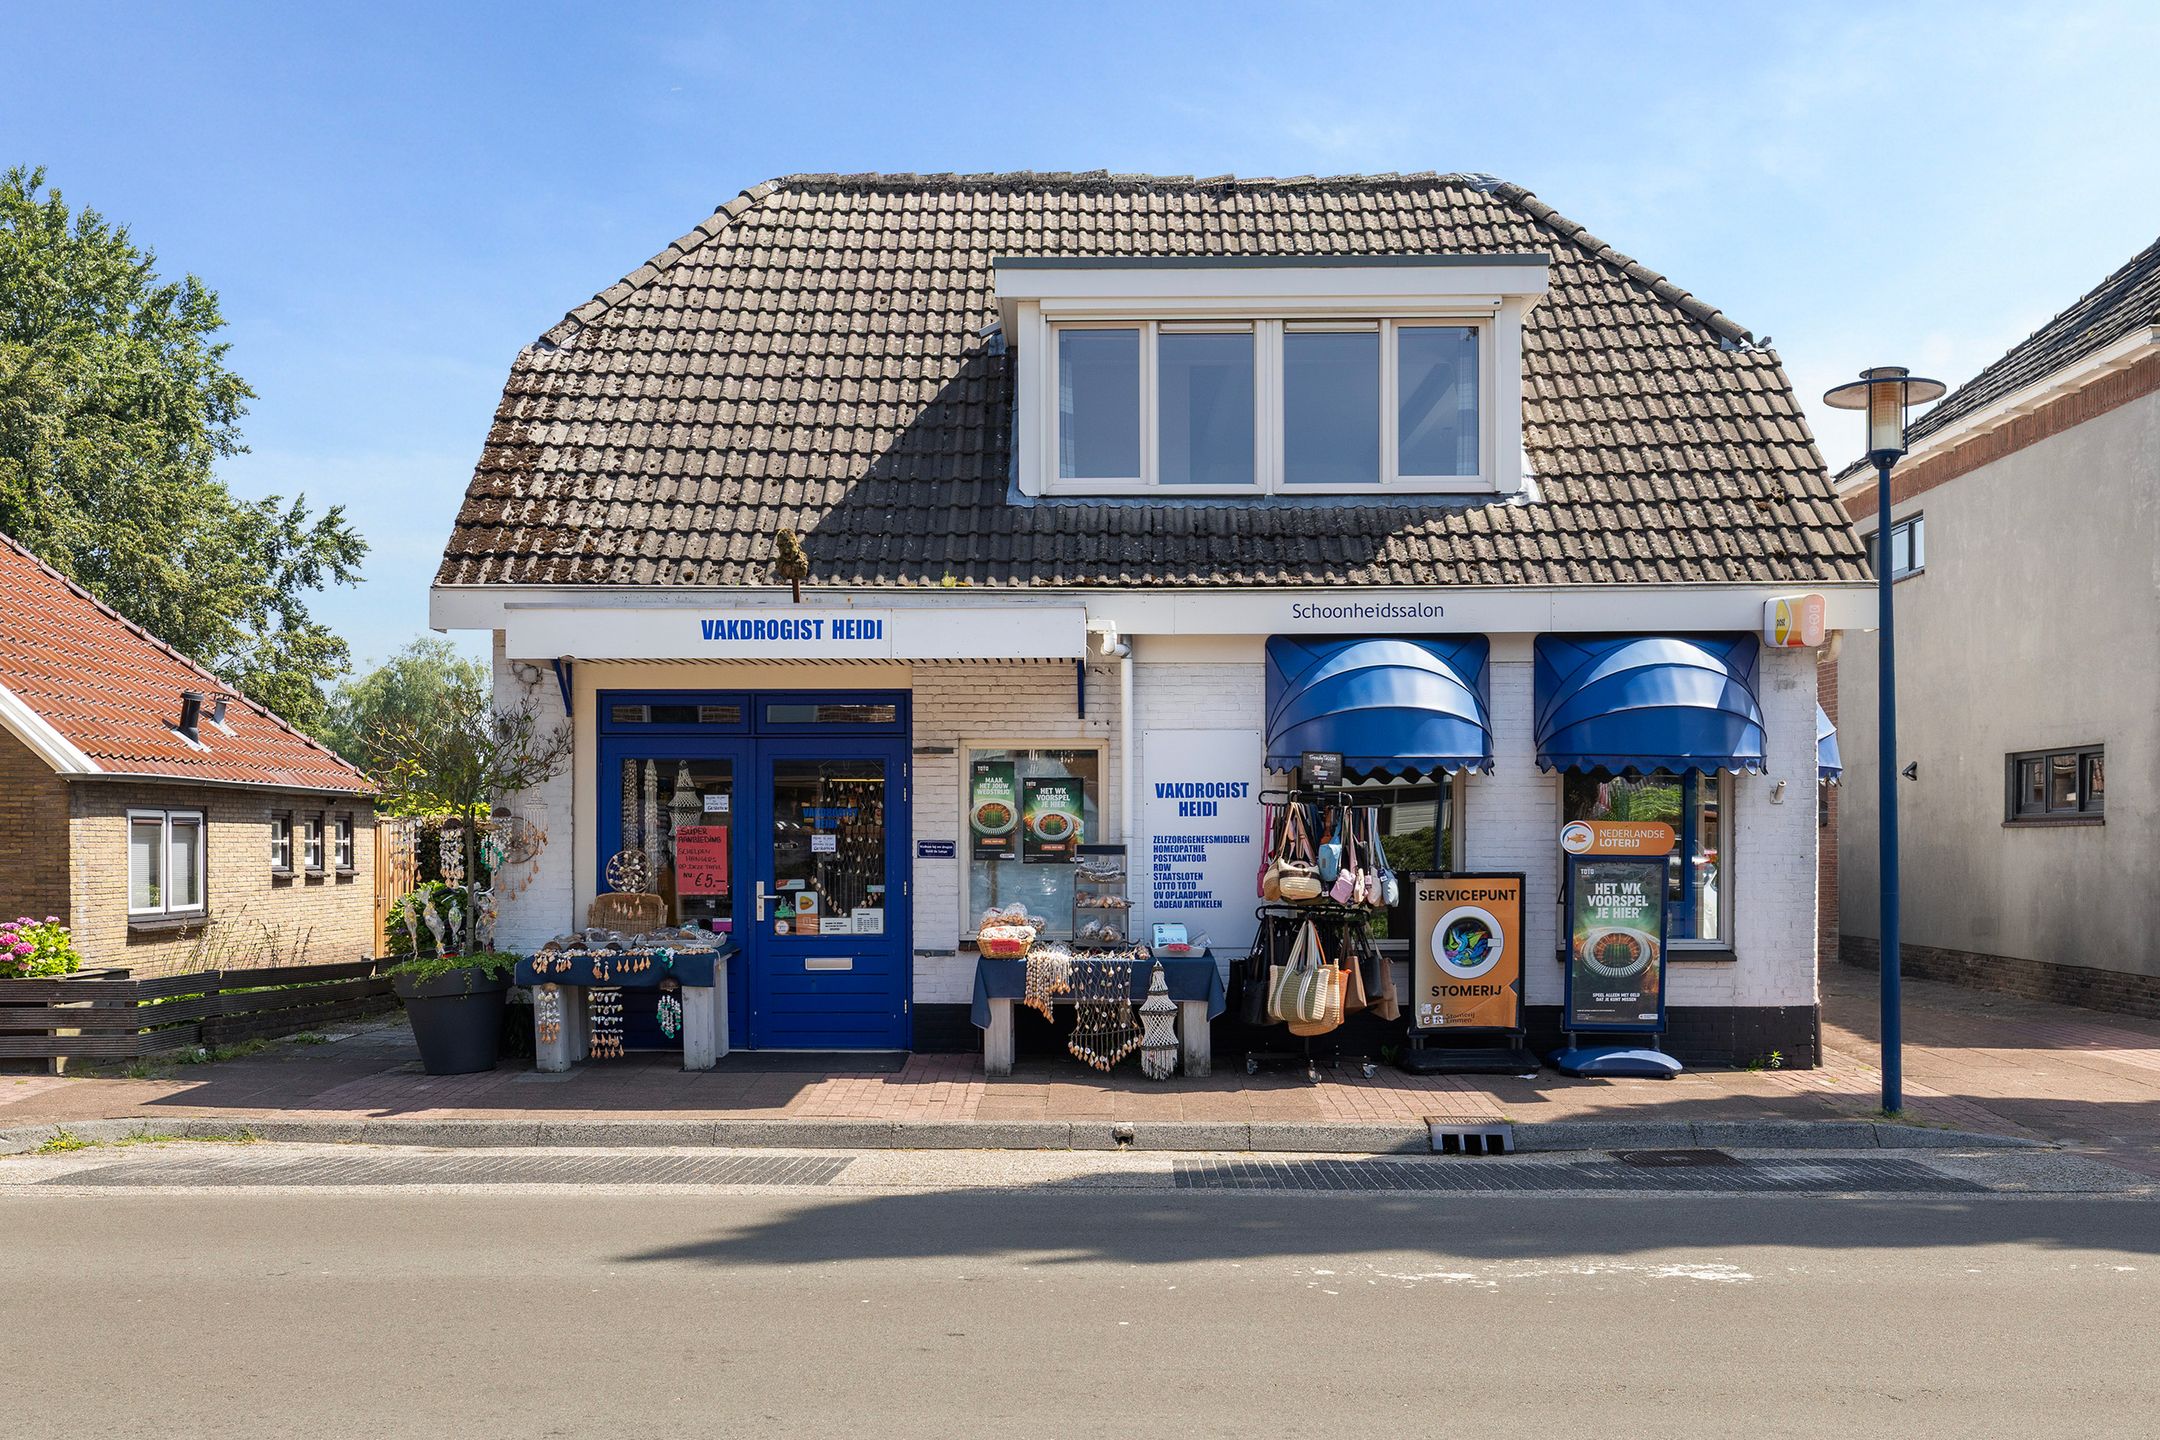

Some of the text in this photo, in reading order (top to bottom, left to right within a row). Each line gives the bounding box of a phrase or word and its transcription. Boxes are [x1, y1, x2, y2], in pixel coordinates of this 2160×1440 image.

[1292, 603, 1444, 618] Schoonheidssalon
[701, 619, 882, 640] VAKDROGIST HEIDI
[1155, 782, 1249, 799] VAKDROGIST
[1179, 801, 1217, 817] HEIDI
[680, 827, 708, 835] SUPER
[1599, 829, 1665, 839] NEDERLANDSE
[1153, 835, 1250, 844] ZELFZORGGENEESMIDDELEN
[1599, 838, 1640, 848] LOTERIJ
[1153, 845, 1205, 853] HOMEOPATHIE
[1153, 854, 1207, 862] POSTKANTOOR
[1153, 863, 1171, 872] RDW
[1153, 872, 1203, 881] STAATSLOTEN
[1153, 881, 1197, 890] LOTTO TOTO
[1595, 883, 1642, 895] HET WK
[1153, 891, 1213, 900] OV OPLAADPUNT
[1419, 889, 1517, 901] SERVICEPUNT
[1153, 900, 1222, 909] CADEAU ARTIKELEN
[1587, 895, 1649, 907] VOORSPEL
[1595, 907, 1609, 919] JE
[1431, 985, 1502, 997] STOMERIJ
